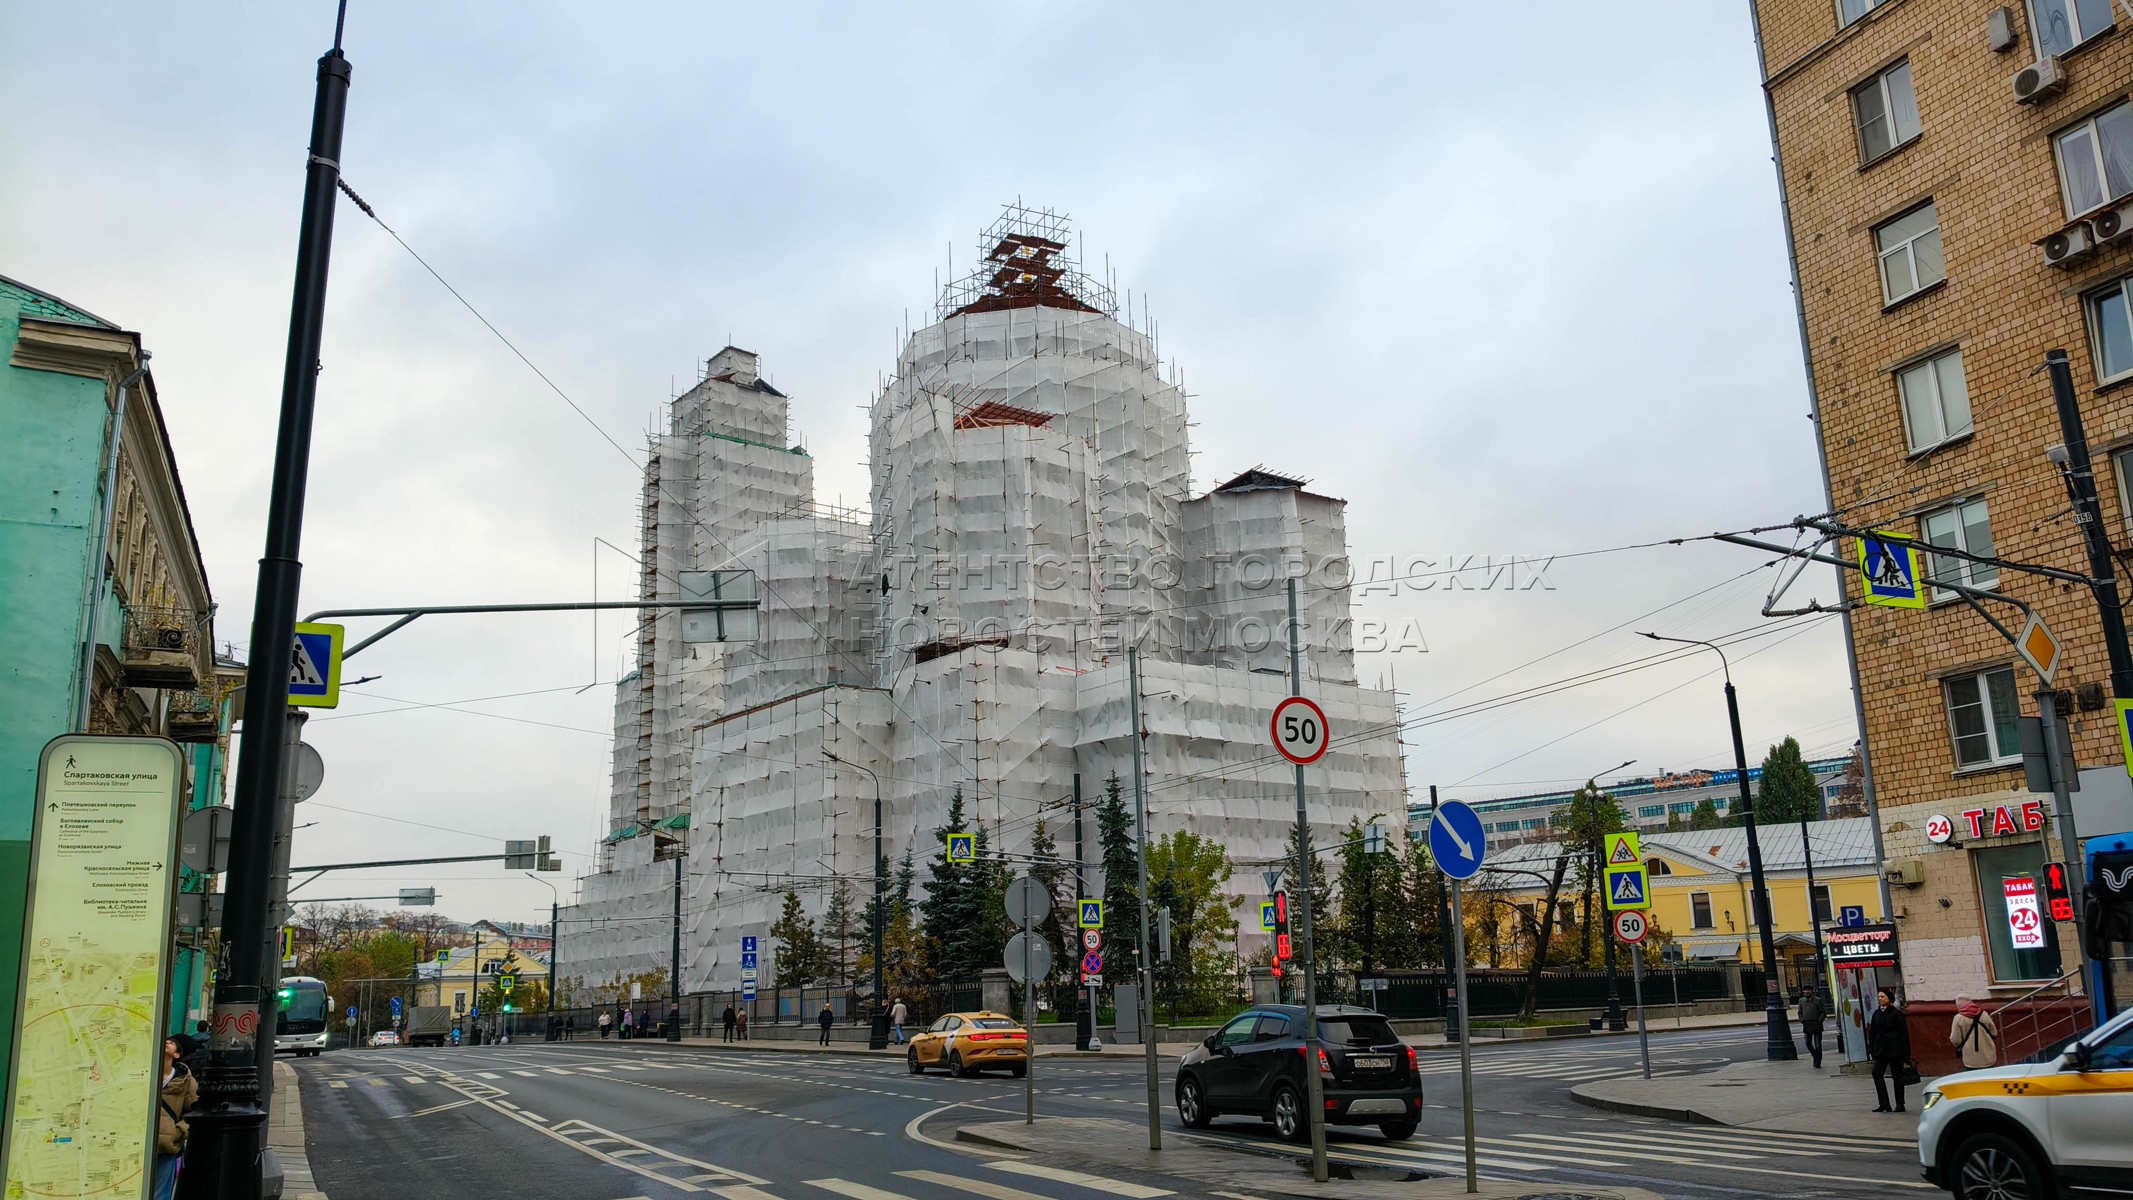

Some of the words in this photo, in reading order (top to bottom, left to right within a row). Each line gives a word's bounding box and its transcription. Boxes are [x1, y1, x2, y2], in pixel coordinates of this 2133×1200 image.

[1285, 716, 1316, 744] 50
[63, 771, 130, 780] Спартаковская
[131, 773, 158, 781] улица
[1928, 821, 1949, 837] 24
[2005, 882, 2035, 892] ТАБАК
[1846, 908, 1859, 926] P
[2013, 911, 2036, 928] 24
[1622, 919, 1640, 932] 50
[1087, 935, 1097, 944] 50
[1827, 930, 1891, 943] Мосцветторг
[2017, 935, 2036, 943] ВХОД
[1843, 943, 1880, 956] ЦВЕТЫ
